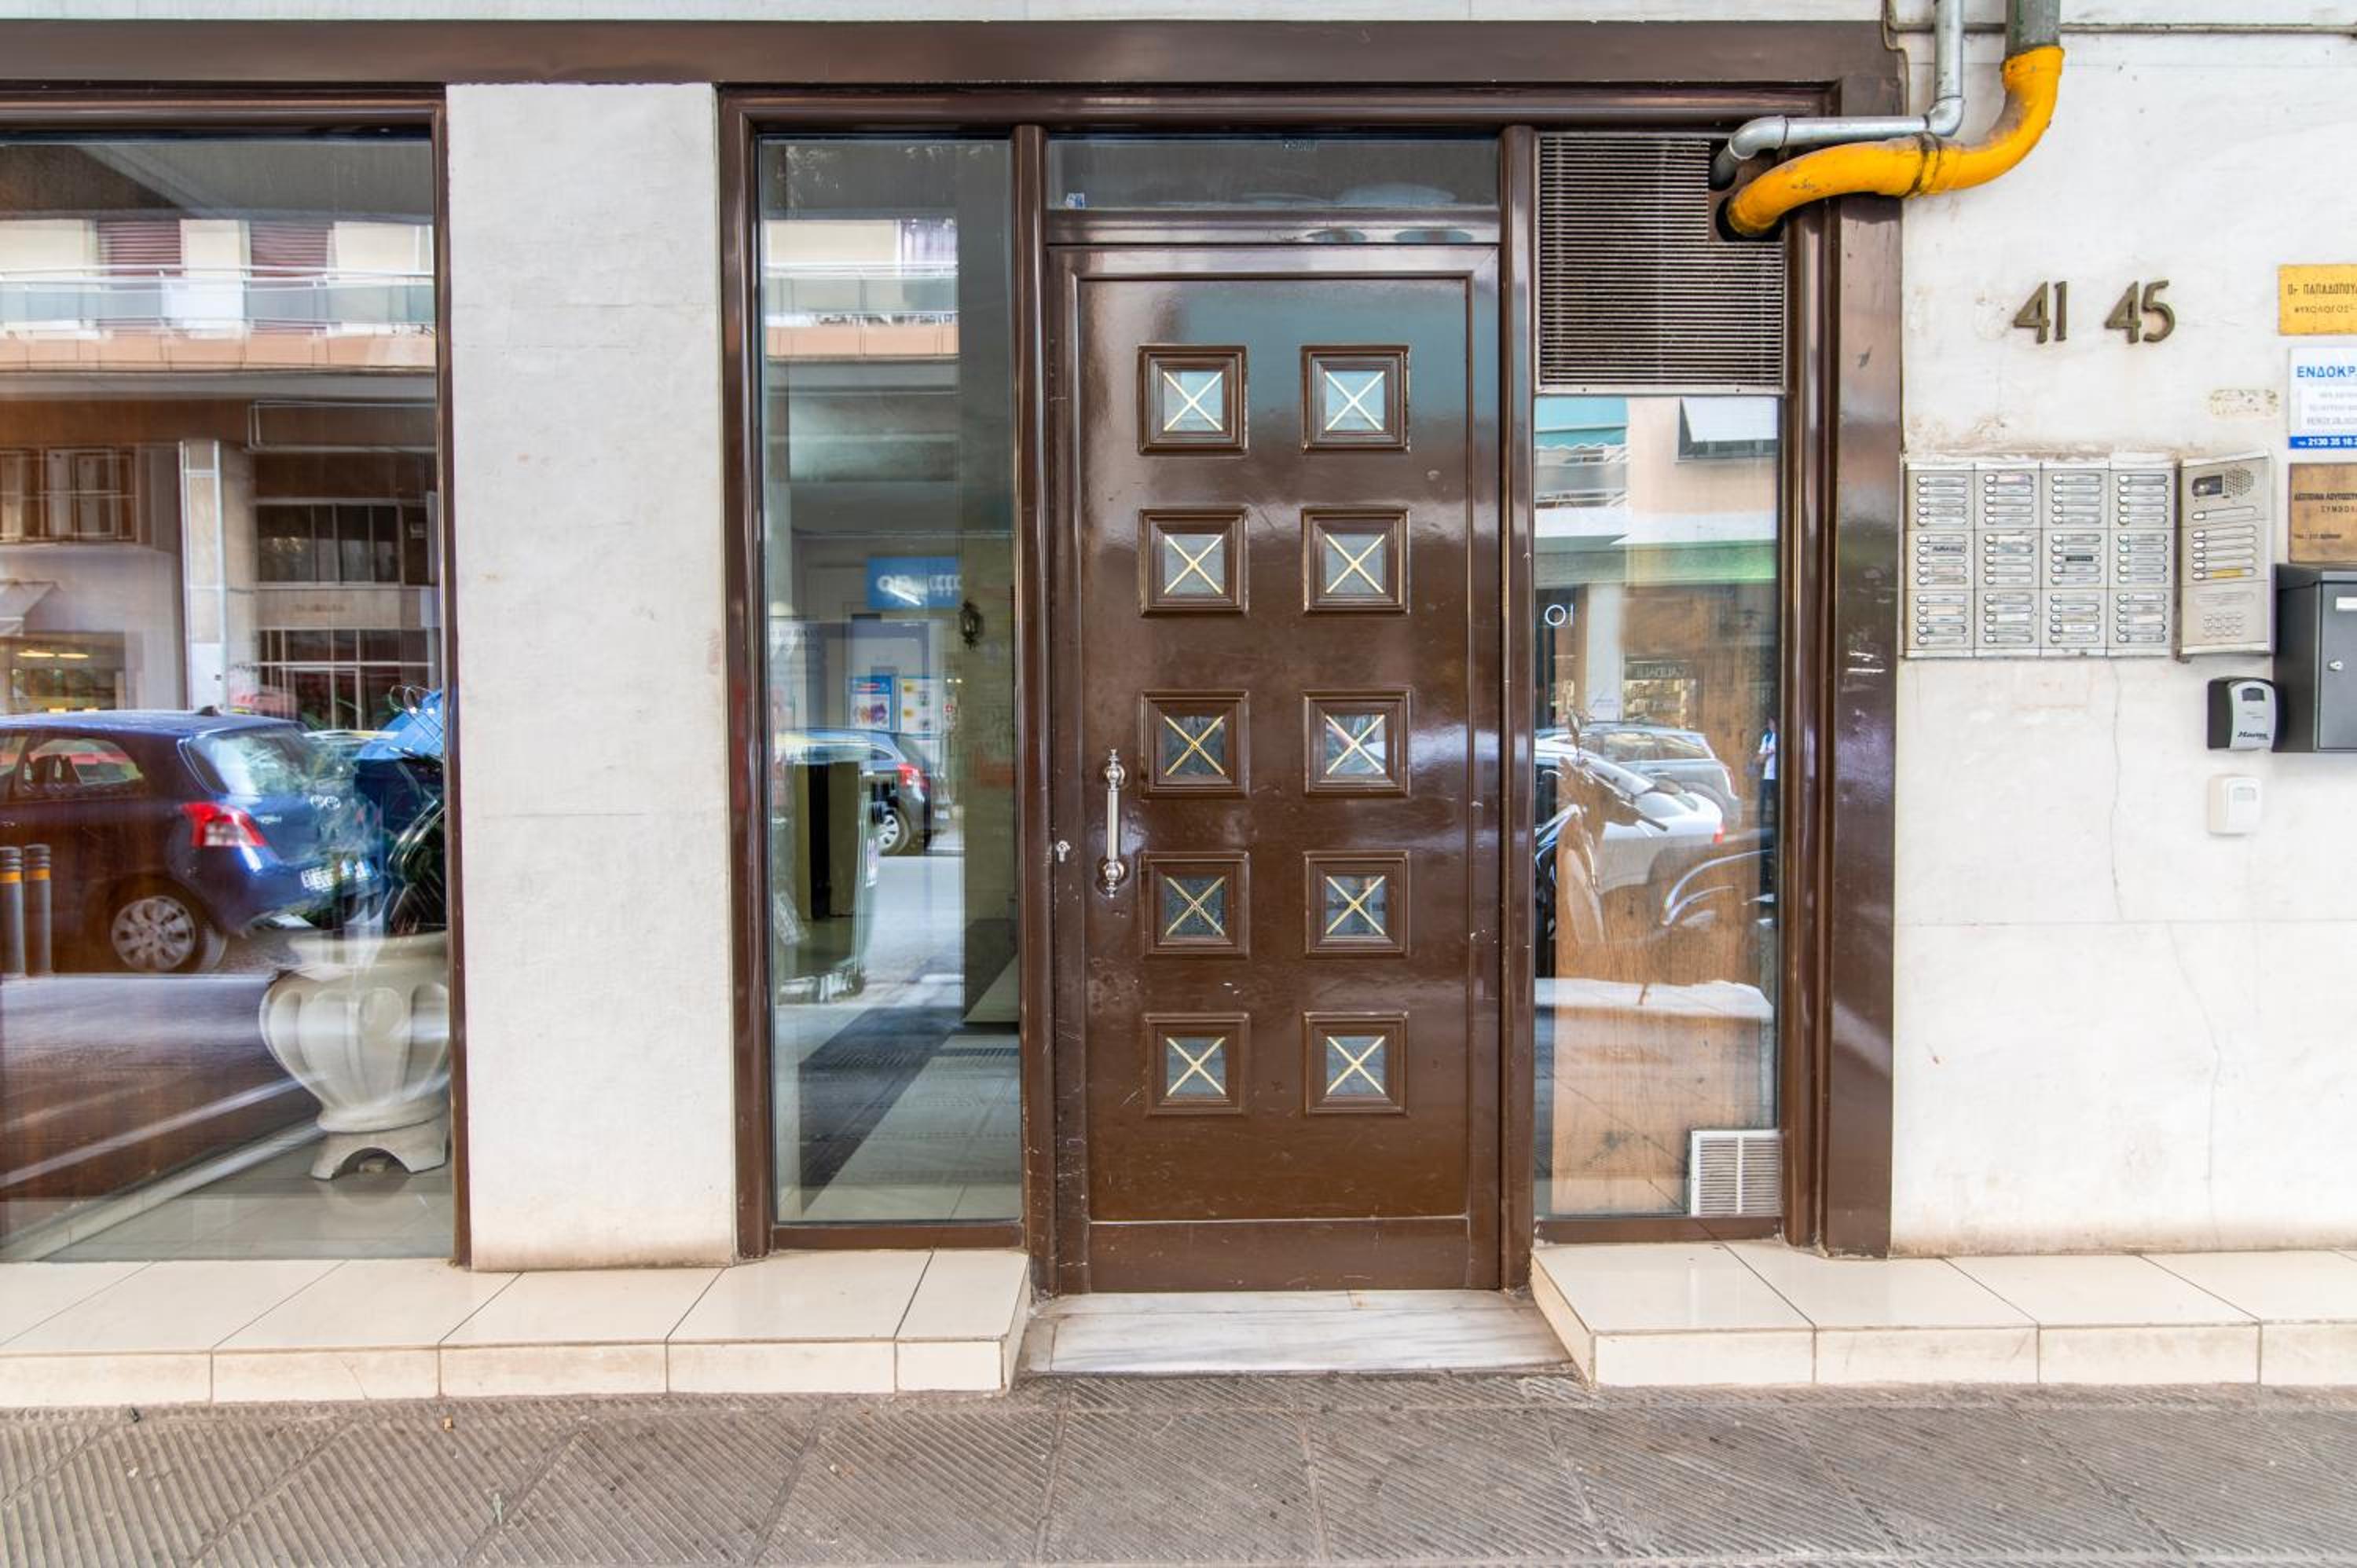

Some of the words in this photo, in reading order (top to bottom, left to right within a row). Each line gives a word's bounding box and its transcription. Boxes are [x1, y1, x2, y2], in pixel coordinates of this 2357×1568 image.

[2303, 283, 2357, 295] ΠΑΠΑΔΟΠΟΥ
[2012, 280, 2067, 343] 41
[2104, 280, 2176, 343] 45
[2297, 365, 2357, 378] ΕΝΔΟΚΡ
